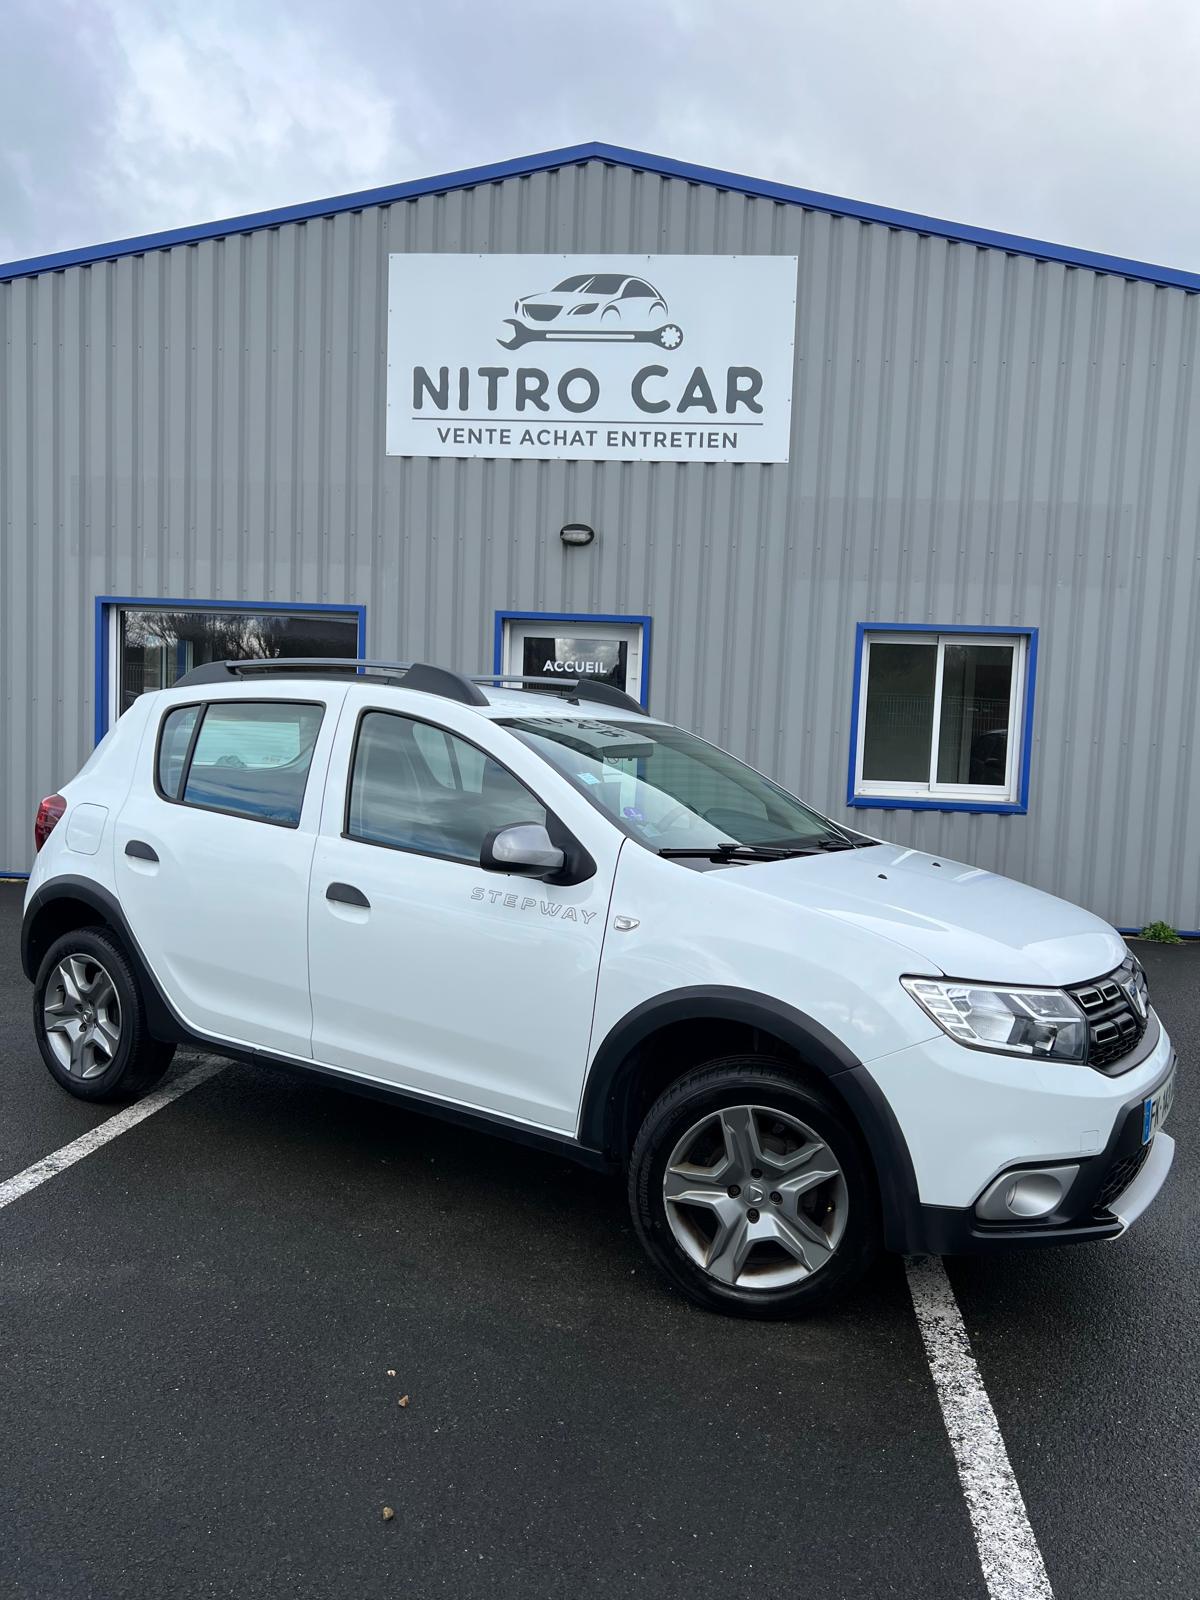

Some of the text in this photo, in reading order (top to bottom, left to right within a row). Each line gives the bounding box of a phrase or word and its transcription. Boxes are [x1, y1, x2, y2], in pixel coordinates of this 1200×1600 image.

[412, 364, 764, 415] NITRO CAR
[436, 427, 738, 449] VENTE ACHAT ENTRETIEN
[542, 659, 608, 674] ACCUEIL
[470, 886, 597, 925] STEPWAY
